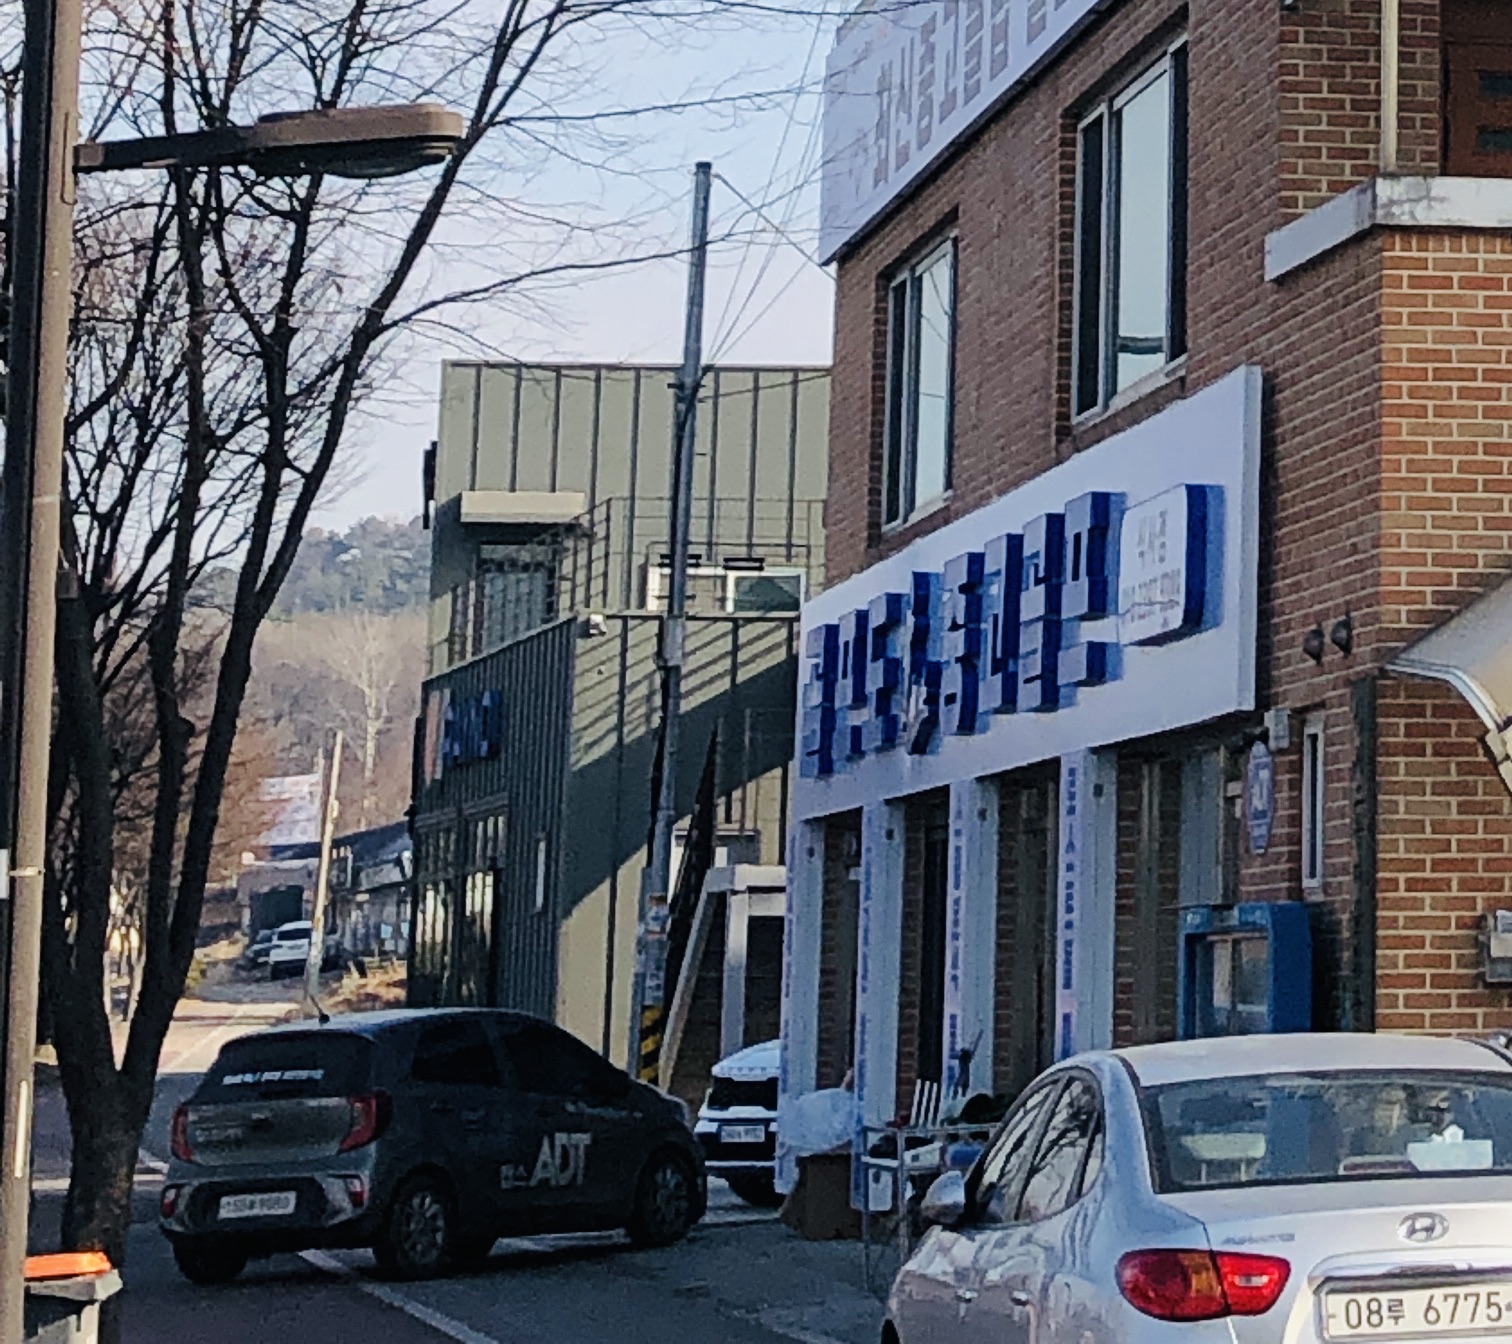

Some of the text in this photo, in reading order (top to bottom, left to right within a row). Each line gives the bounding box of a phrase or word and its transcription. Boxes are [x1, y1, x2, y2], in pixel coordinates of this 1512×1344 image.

[528, 1132, 592, 1188] ADT
[1344, 1291, 1503, 1331] 08루 6775
